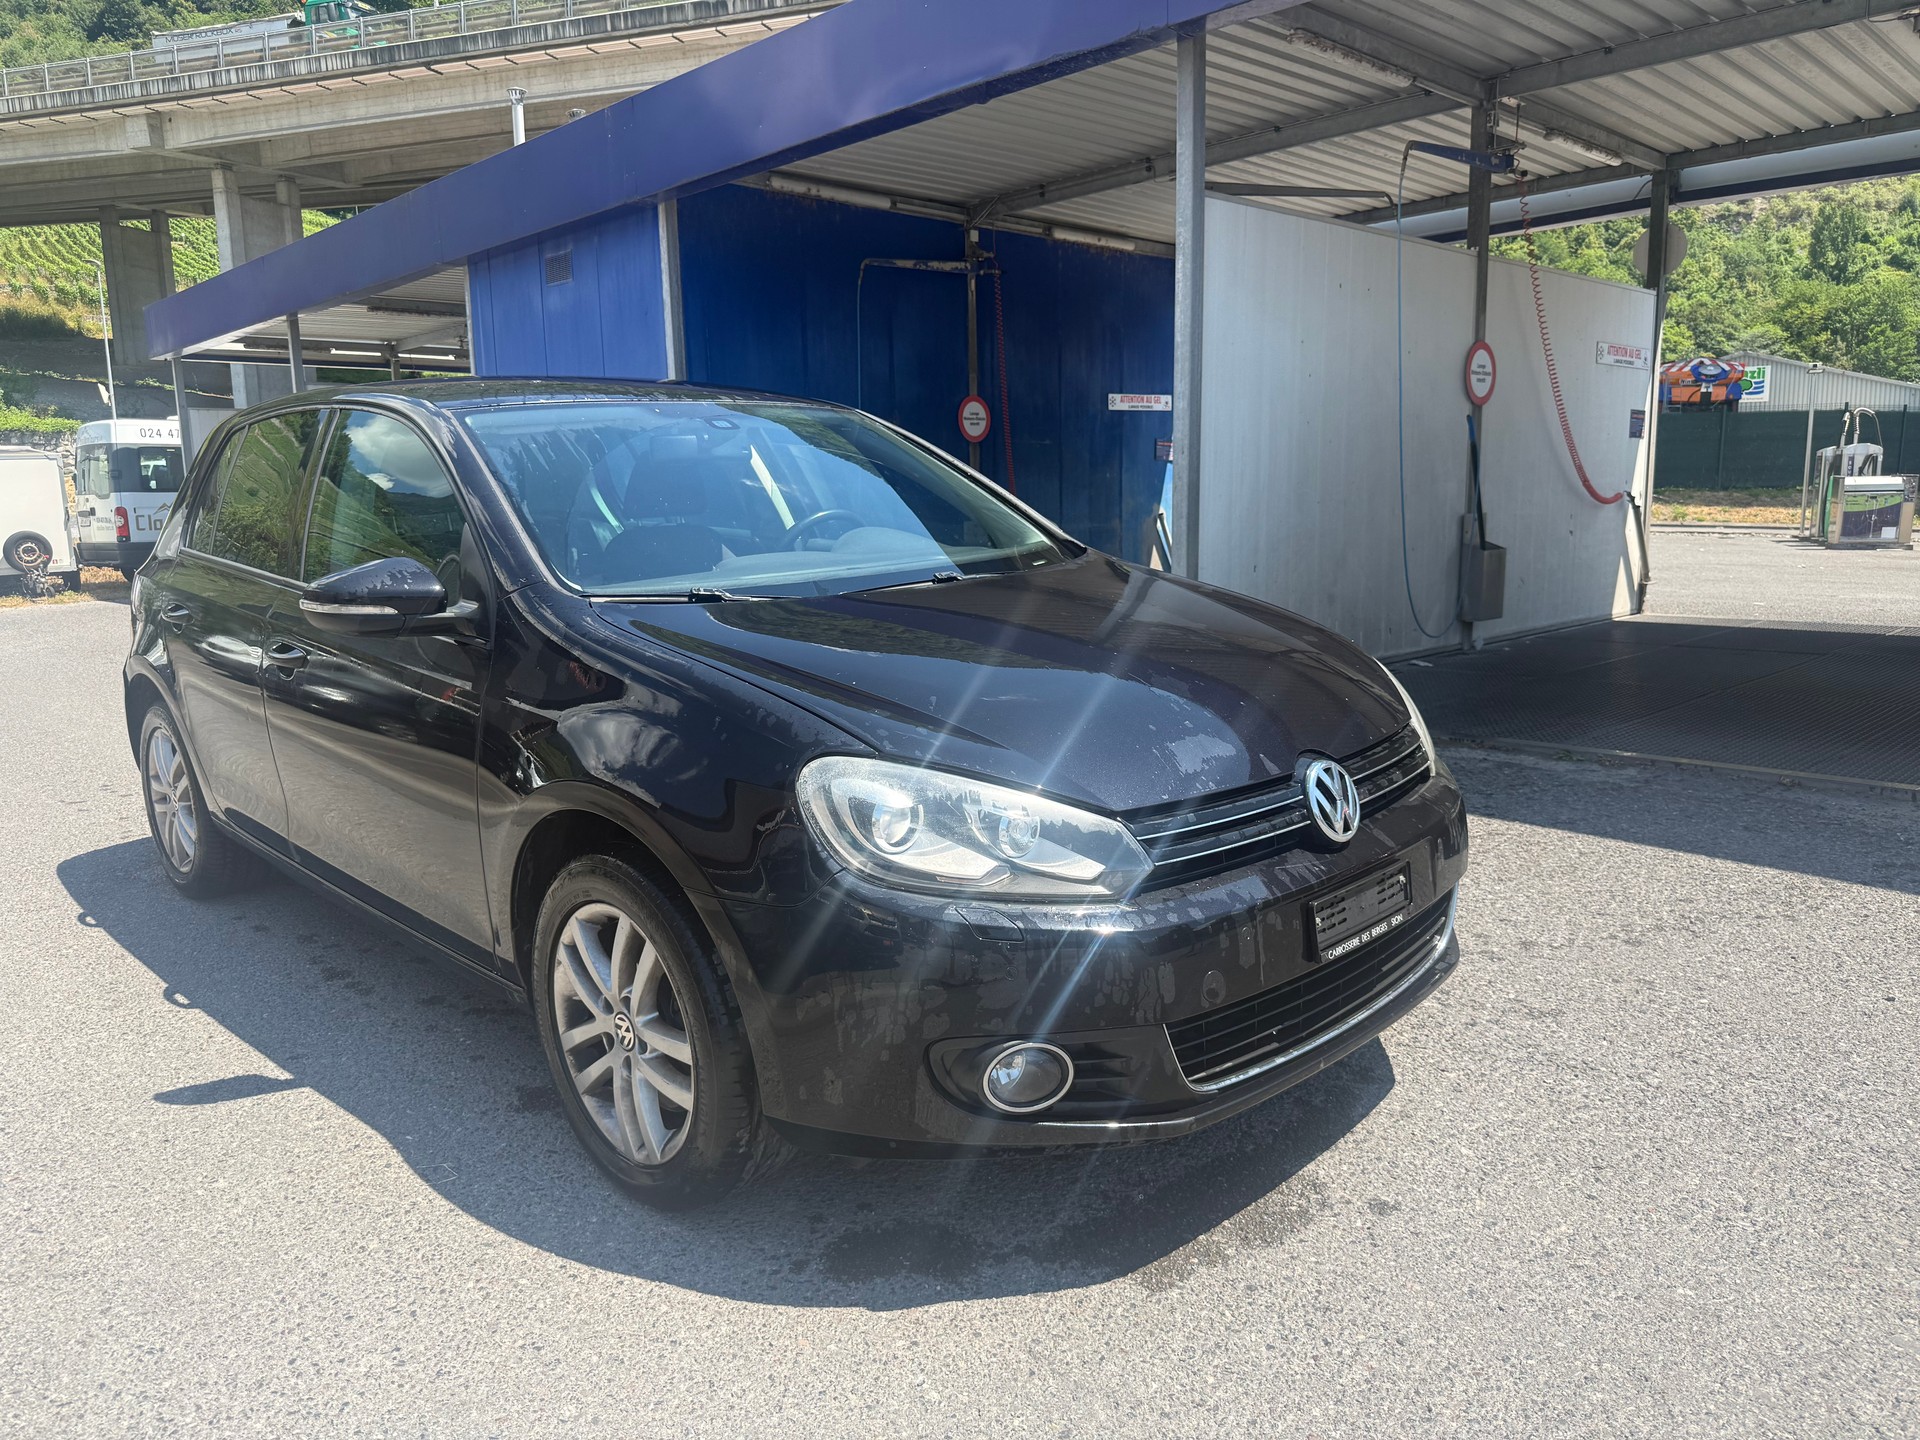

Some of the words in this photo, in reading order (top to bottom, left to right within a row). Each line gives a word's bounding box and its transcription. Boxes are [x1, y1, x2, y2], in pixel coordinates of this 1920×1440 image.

[1608, 345, 1628, 357] ATTENTION
[1629, 348, 1634, 358] AU
[1120, 395, 1145, 403] ATTENTION
[1146, 396, 1152, 404] AU
[1153, 396, 1161, 404] GEL
[140, 428, 161, 438] 024
[168, 429, 180, 438] 47
[1328, 936, 1360, 959] CARROSSERIE
[1361, 931, 1370, 942] DES
[1371, 921, 1388, 937] BERGES
[1391, 913, 1403, 926] SION
